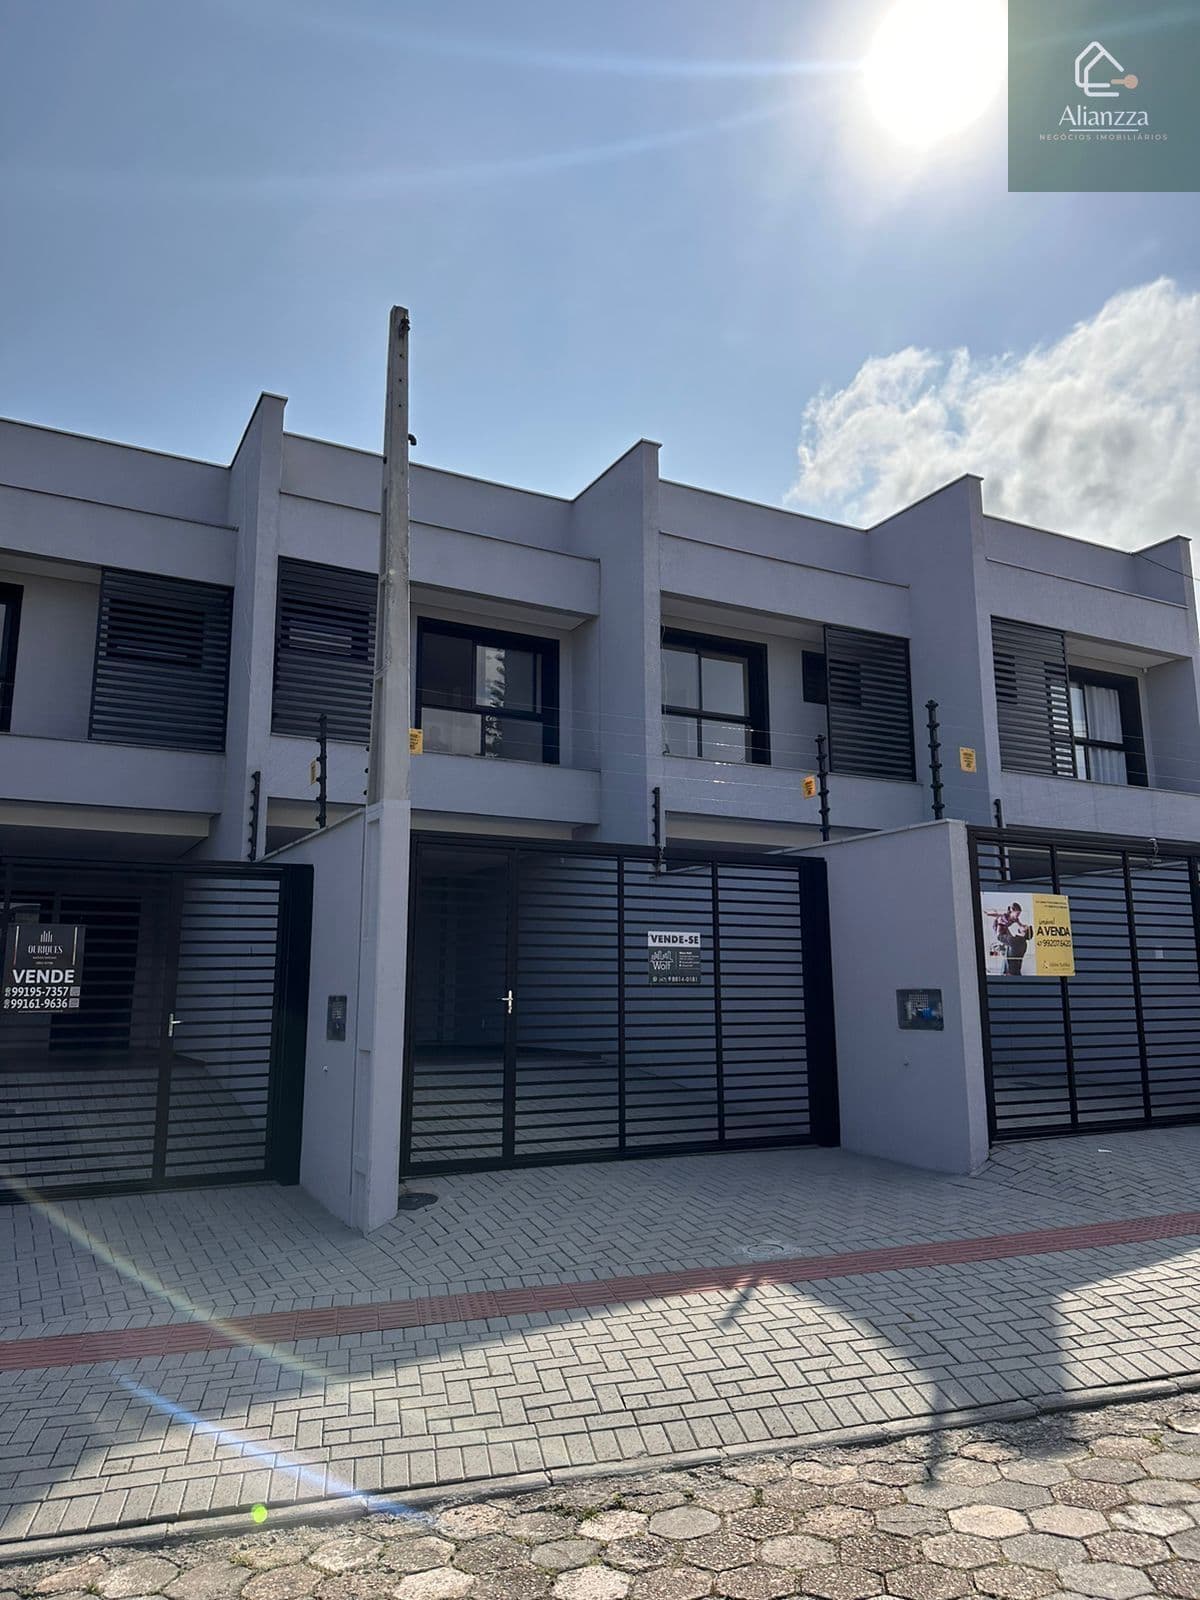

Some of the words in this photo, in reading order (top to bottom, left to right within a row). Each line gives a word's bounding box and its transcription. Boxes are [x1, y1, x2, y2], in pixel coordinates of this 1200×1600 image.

[1044, 926, 1071, 937] VENDA
[650, 934, 699, 945] VENDE-SE
[27, 945, 63, 956] OURIQUES
[12, 969, 75, 984] VENDE
[11, 986, 69, 997] 99195-7357
[10, 998, 68, 1009] 99161-9636
